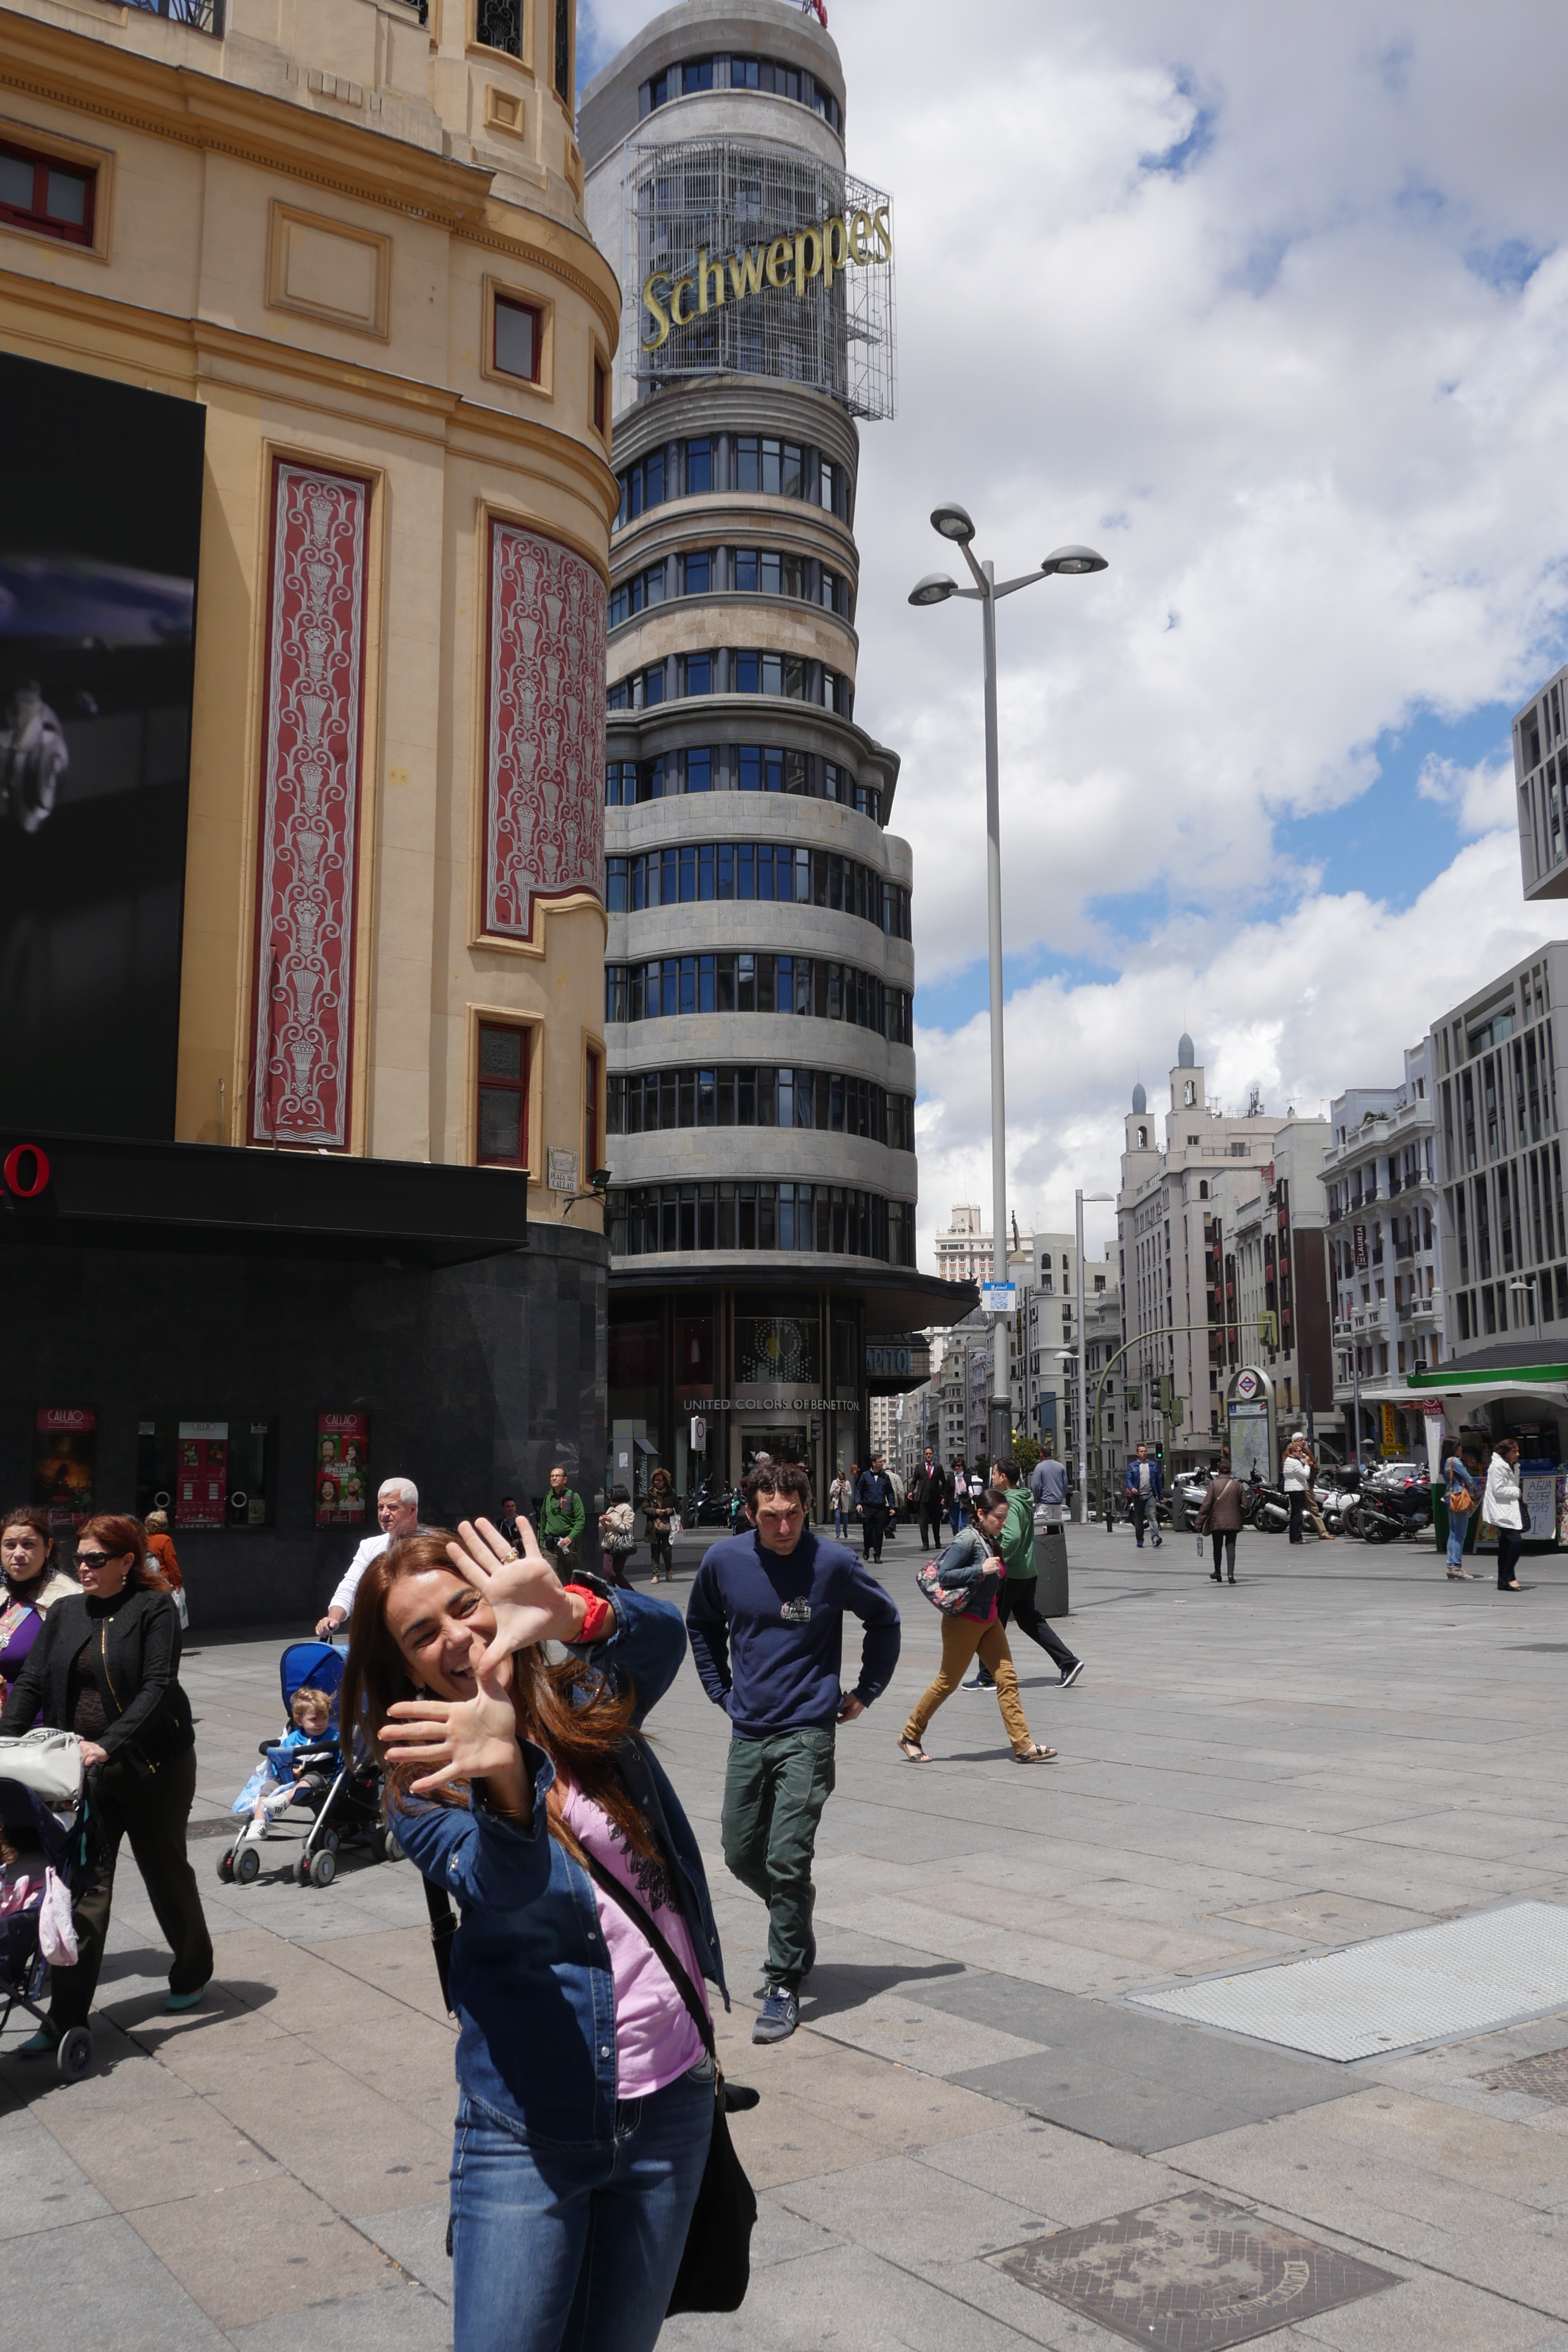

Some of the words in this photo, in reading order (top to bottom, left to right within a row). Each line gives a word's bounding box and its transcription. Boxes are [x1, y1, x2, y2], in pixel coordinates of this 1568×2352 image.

[642, 205, 893, 352] Schweppes
[0, 1144, 50, 1197] O
[551, 1172, 565, 1181] PLAZA
[552, 1180, 574, 1190] CALLAO
[683, 1400, 730, 1410] UNITED
[736, 1400, 788, 1410] COLORS
[793, 1400, 808, 1410] OF
[47, 1410, 83, 1422] CALLAO
[326, 1414, 357, 1425] CALLAO
[1385, 1405, 1393, 1443] PELUCAS
[1526, 1491, 1552, 1501] SUPER
